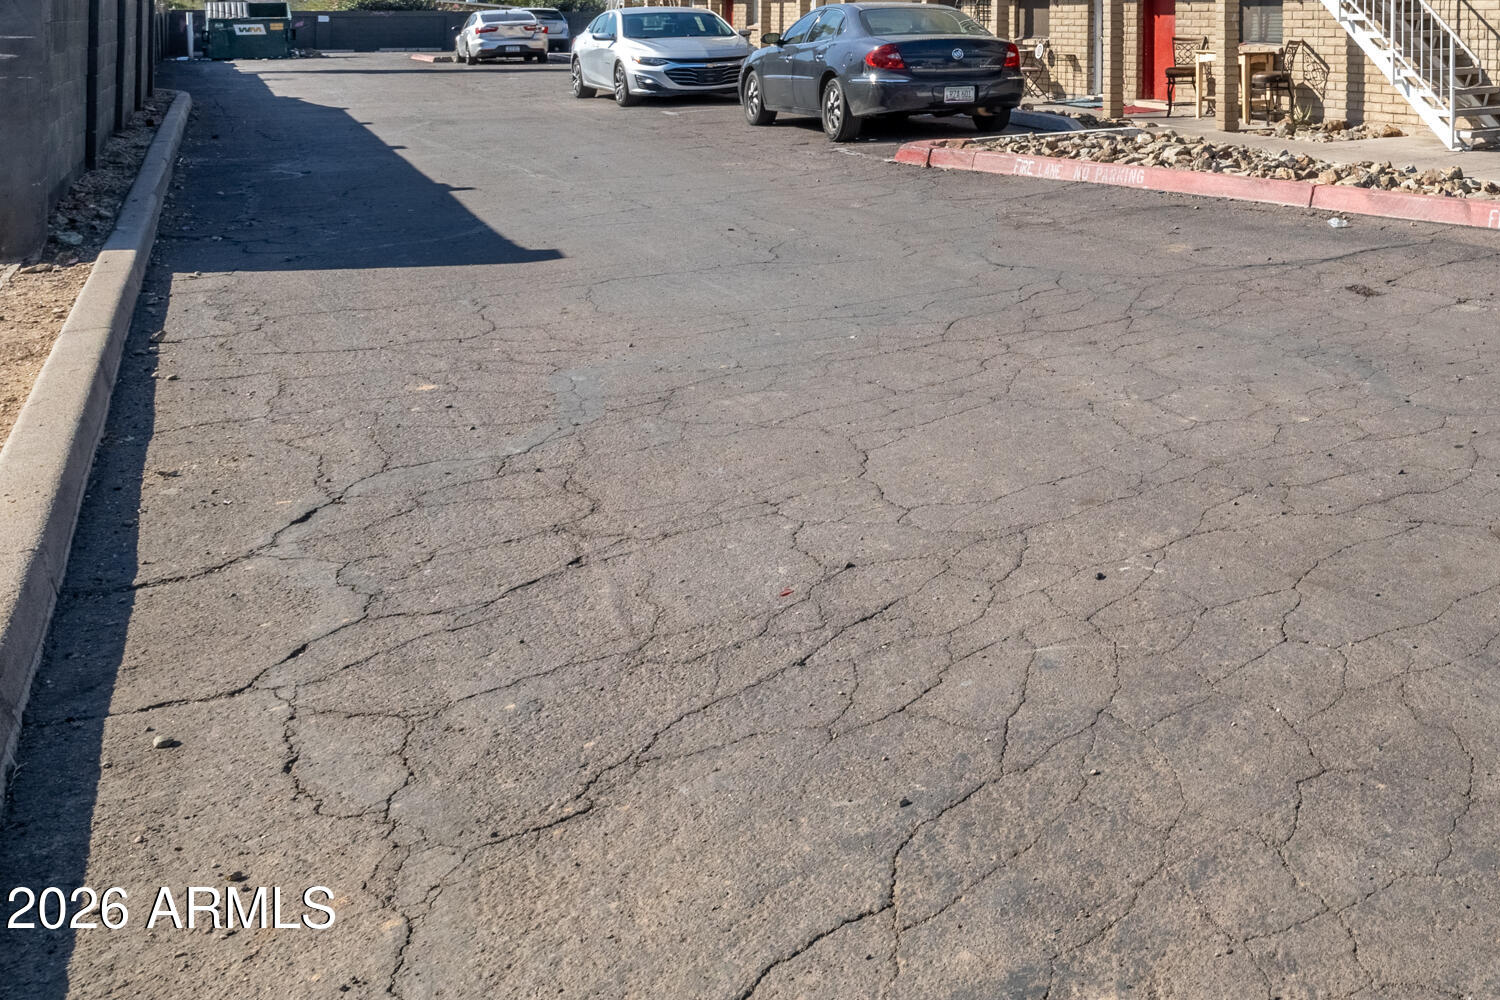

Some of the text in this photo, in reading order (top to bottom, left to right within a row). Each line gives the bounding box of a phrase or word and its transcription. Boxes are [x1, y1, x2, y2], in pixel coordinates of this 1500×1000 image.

[1013, 159, 1145, 185] FIRE LANE NO PARKING
